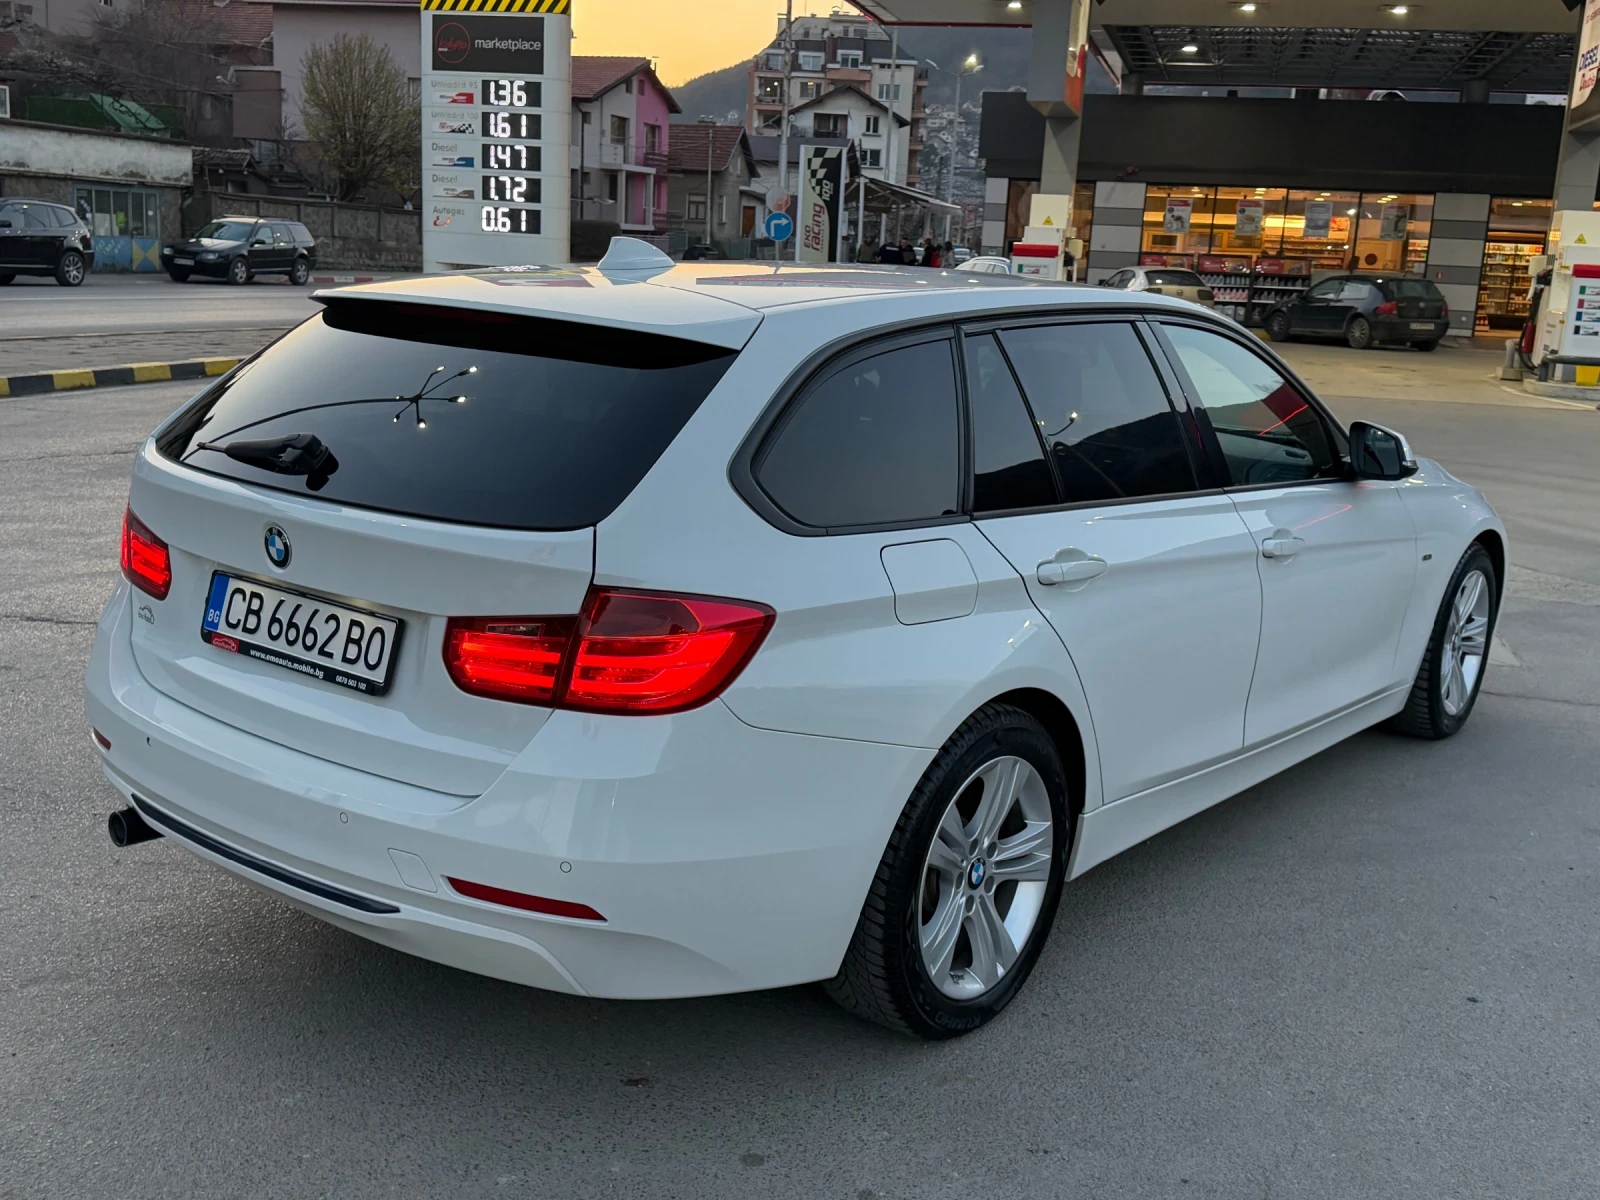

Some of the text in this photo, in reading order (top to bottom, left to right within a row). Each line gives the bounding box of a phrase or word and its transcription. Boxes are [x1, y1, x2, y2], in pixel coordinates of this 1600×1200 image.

[474, 37, 542, 52] marketplace
[489, 79, 527, 107] 1.36
[489, 111, 527, 138] 1.61
[431, 142, 458, 152] Diesel
[489, 144, 527, 169] 1.47
[432, 173, 458, 184] Diesel
[489, 175, 527, 203] 1.72
[821, 180, 831, 201] 100
[432, 205, 465, 216] Autogas
[481, 205, 527, 233] 0.61
[803, 224, 812, 249] EKO
[811, 202, 826, 252] racing
[207, 608, 221, 624] BG
[249, 648, 325, 680] www.emoauto.mobile.bg
